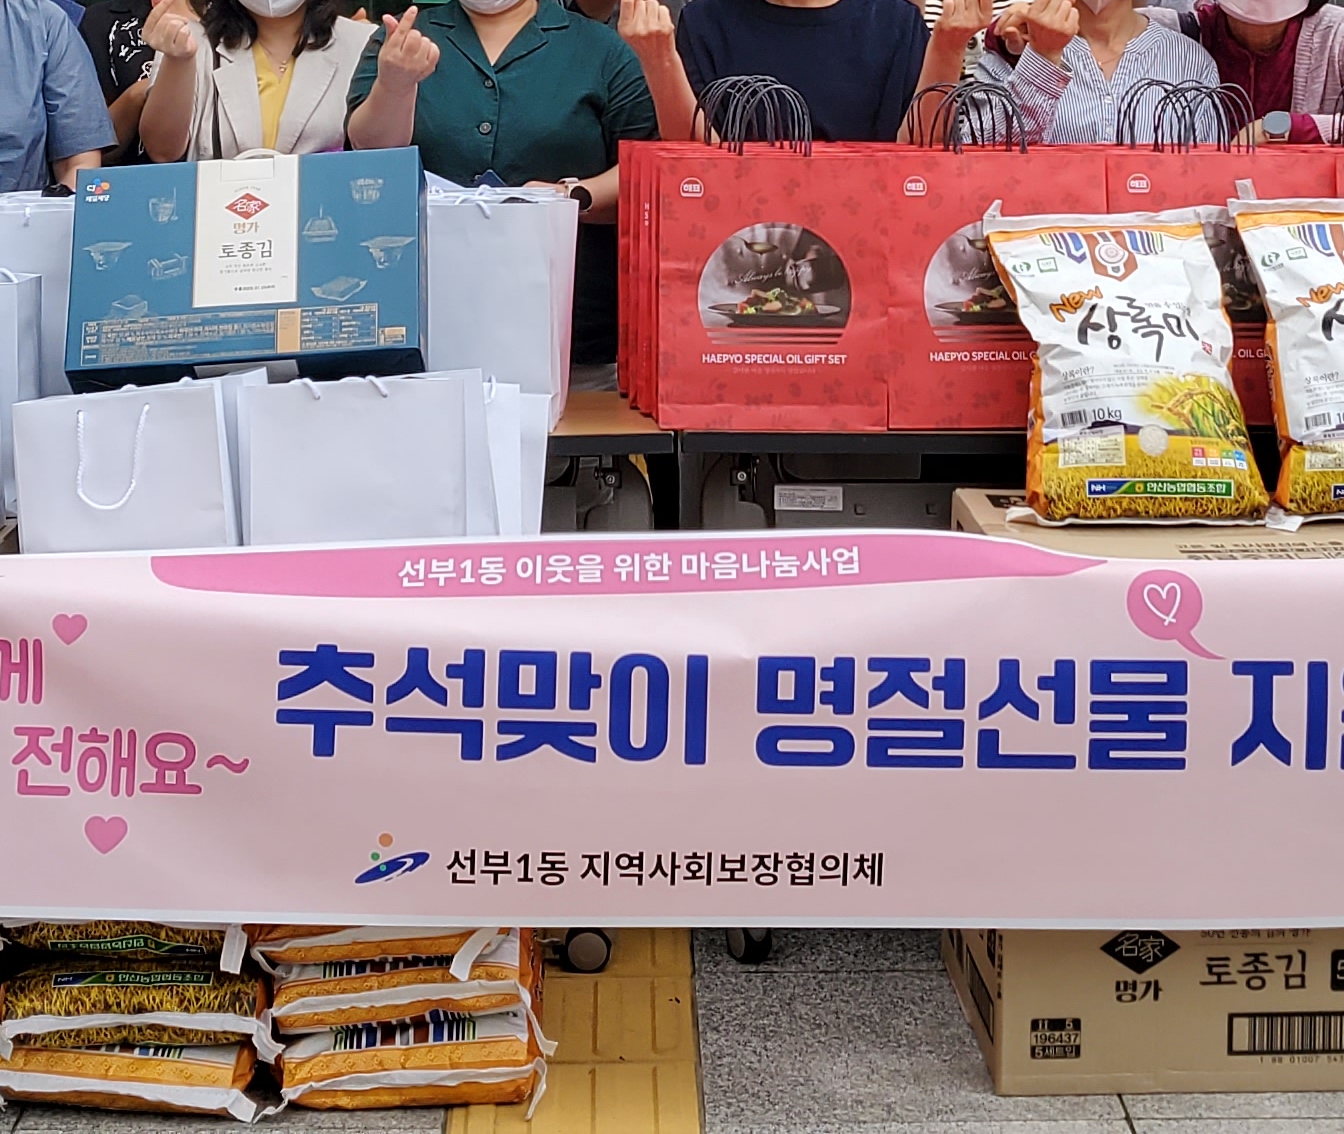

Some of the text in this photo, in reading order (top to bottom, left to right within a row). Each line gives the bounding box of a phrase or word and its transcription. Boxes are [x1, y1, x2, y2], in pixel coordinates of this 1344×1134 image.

[233, 198, 262, 214] 名家
[233, 221, 260, 235] 명가
[218, 239, 273, 260] 토종김
[1049, 286, 1103, 323] New
[1077, 296, 1200, 363] 상록미
[702, 353, 847, 365] HAEPYO SPECIAL OIL GIFT SET
[930, 351, 1028, 362] HAEPYO SPECIAL OIL
[1237, 349, 1255, 358] OIL
[1092, 407, 1122, 421] 10 kg
[1146, 483, 1226, 494] 안산농업협동조합
[397, 547, 861, 588] 선부1동 이웃을 위한 마음나눔사업
[274, 643, 710, 767] 추석맞이
[754, 655, 1189, 773] 명절선물
[11, 725, 252, 800] 전해요~
[445, 848, 885, 889] 선부1동 지역사회보장협의체
[1115, 933, 1165, 962] 名家
[1199, 949, 1307, 990] 토종김
[1115, 979, 1164, 1003] 명가
[1033, 1032, 1079, 1044] 196437
[1035, 1046, 1076, 1058] 5세트입
